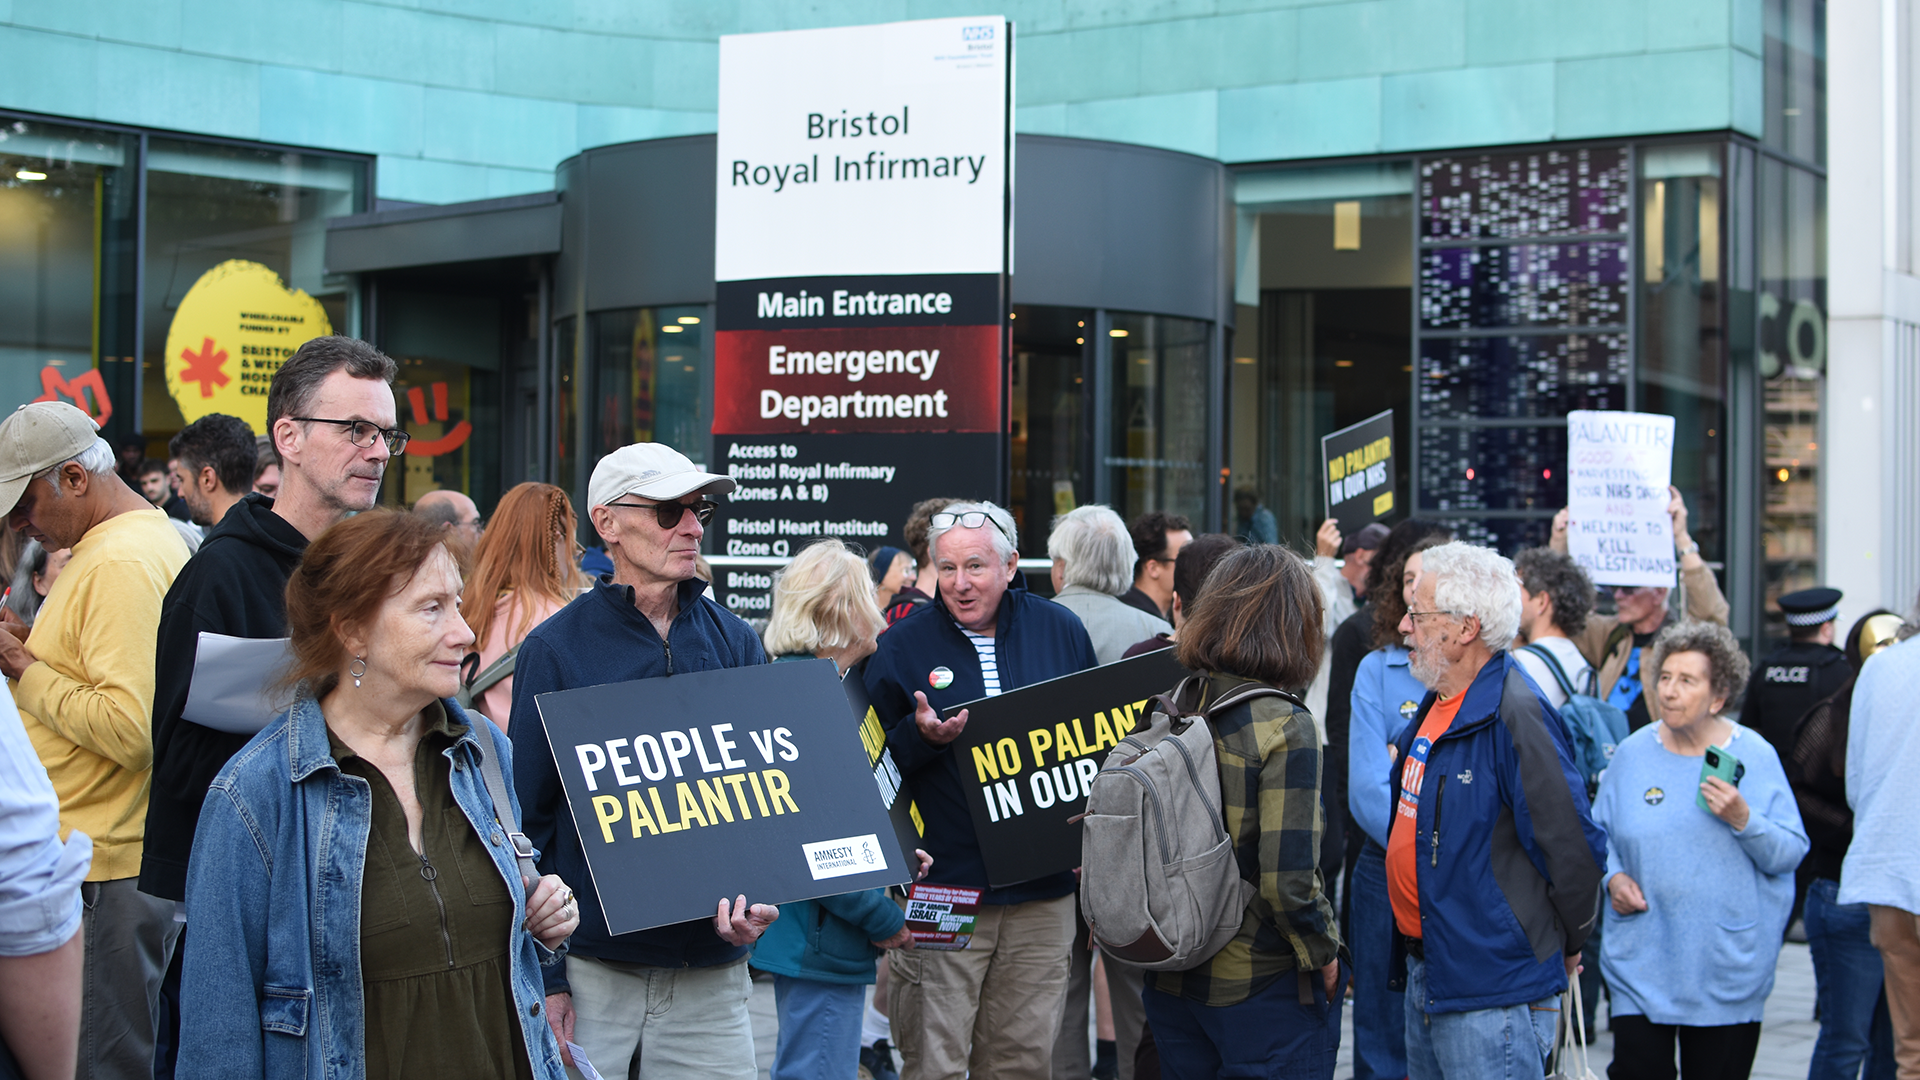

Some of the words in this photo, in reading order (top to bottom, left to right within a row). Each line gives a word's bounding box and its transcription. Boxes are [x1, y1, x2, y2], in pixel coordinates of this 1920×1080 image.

[807, 105, 909, 139] Bristol
[732, 154, 818, 193] Royal
[835, 151, 986, 184] Infirmary
[757, 290, 824, 318] Main
[832, 290, 952, 317] Entrance
[242, 359, 250, 368] &
[254, 360, 284, 369] WES
[769, 345, 940, 382] Emergency
[241, 385, 269, 396] CHA
[760, 389, 949, 426] Department
[1570, 420, 1669, 448] PALANTIR
[727, 442, 777, 459] Access
[779, 443, 798, 459] to
[1329, 456, 1345, 482] NO
[1346, 436, 1391, 476] PALANTIR
[727, 463, 776, 480] Bristol
[778, 462, 821, 483] Royal
[824, 462, 896, 483] Infirmary
[1330, 481, 1343, 506] IN
[1344, 470, 1366, 500] OUR
[1366, 461, 1387, 490] NHS
[1606, 484, 1632, 499] NHS
[727, 484, 778, 503] (Zones
[780, 485, 793, 500] A
[796, 486, 809, 501] &
[812, 484, 829, 503] B)
[727, 518, 775, 535] Bristol
[778, 519, 821, 535] Heart
[824, 519, 889, 536] Institute
[1581, 519, 1638, 535] HELPING
[1646, 522, 1662, 536] TO
[726, 539, 770, 557] (Zone
[772, 539, 789, 557] C)
[1597, 537, 1636, 555] KILL
[727, 571, 771, 588] Bristo
[726, 593, 771, 610] Oncol
[1765, 666, 1810, 682] POLICE
[971, 737, 1022, 784] NO
[1028, 699, 1148, 768] PALANT
[574, 722, 747, 792] PEOPLE
[591, 768, 800, 844] PALANTIR
[983, 779, 1024, 823] IN
[814, 846, 853, 862] AMNESTY
[817, 858, 857, 870] INTERNATIONAL
[909, 908, 938, 920] ISRAEL
[911, 901, 926, 909] STOP
[938, 922, 962, 932] NOW
[941, 914, 974, 924] SANCTIONS
